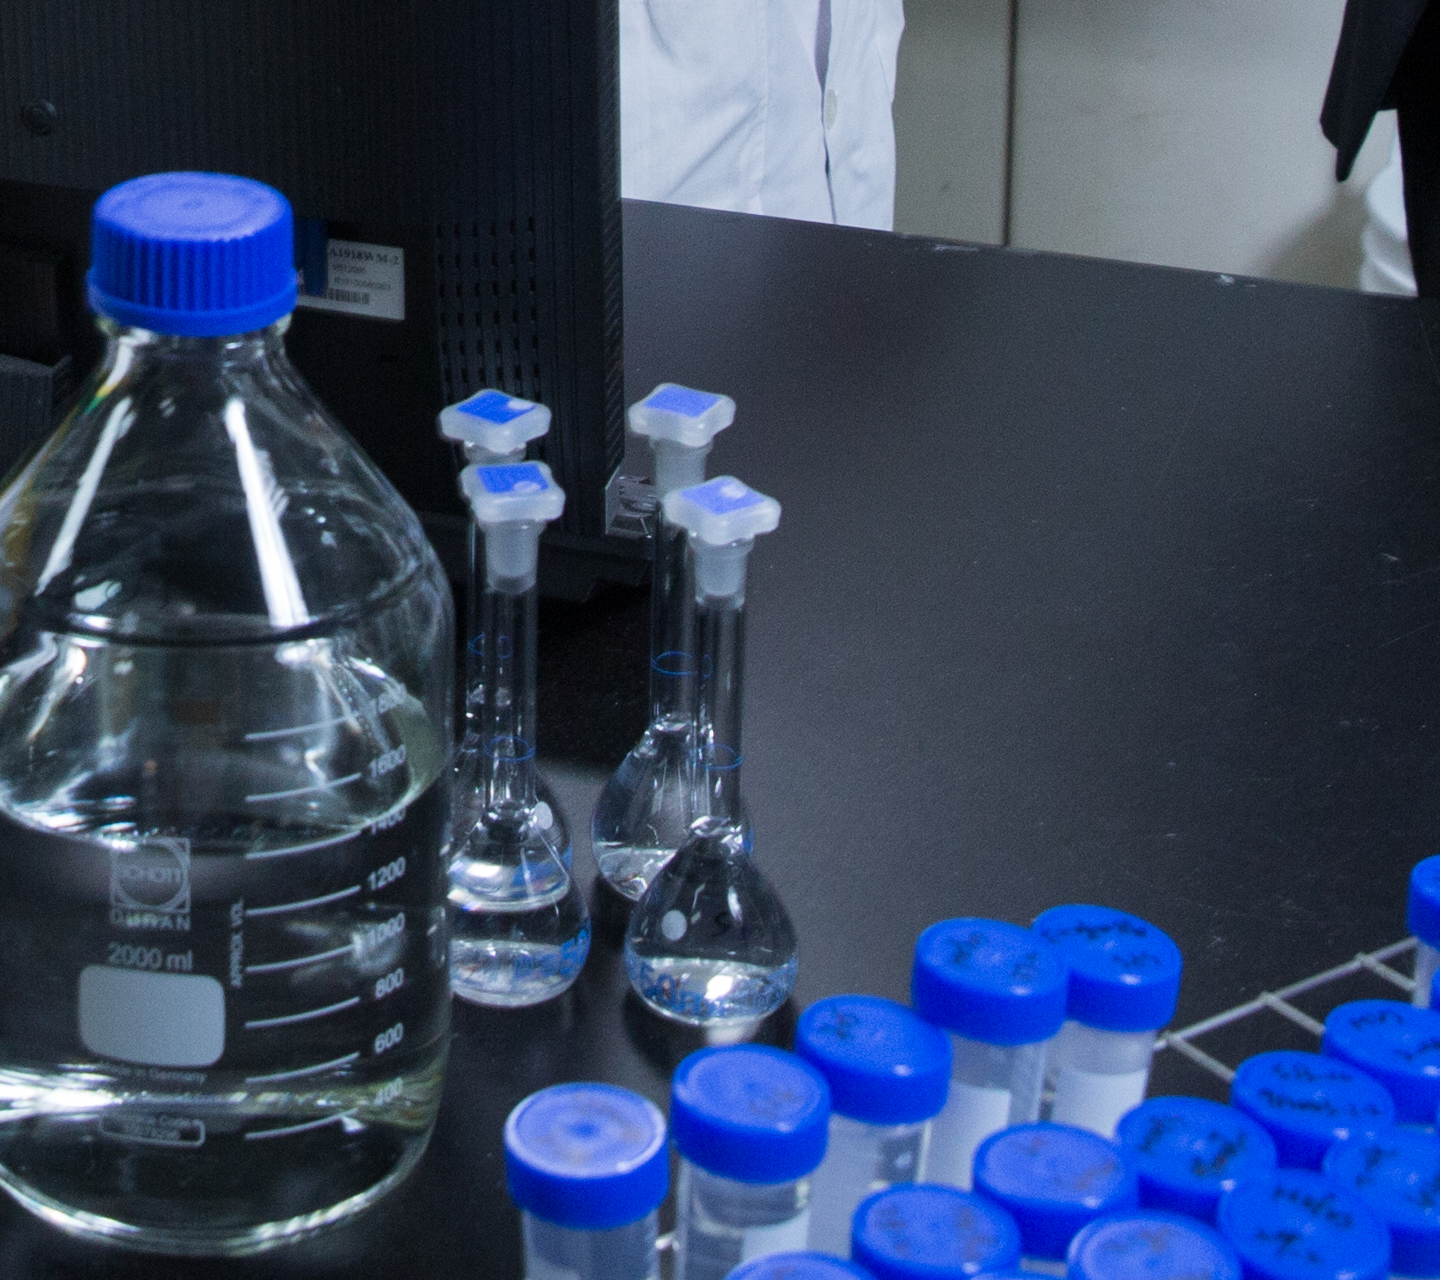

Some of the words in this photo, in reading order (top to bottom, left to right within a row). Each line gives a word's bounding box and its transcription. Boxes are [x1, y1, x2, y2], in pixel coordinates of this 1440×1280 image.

[368, 855, 407, 891] 1200
[368, 913, 406, 948] 1000
[108, 944, 163, 970] 2000
[166, 950, 193, 971] ml
[374, 967, 406, 1000] 800
[374, 1022, 405, 1054] 600
